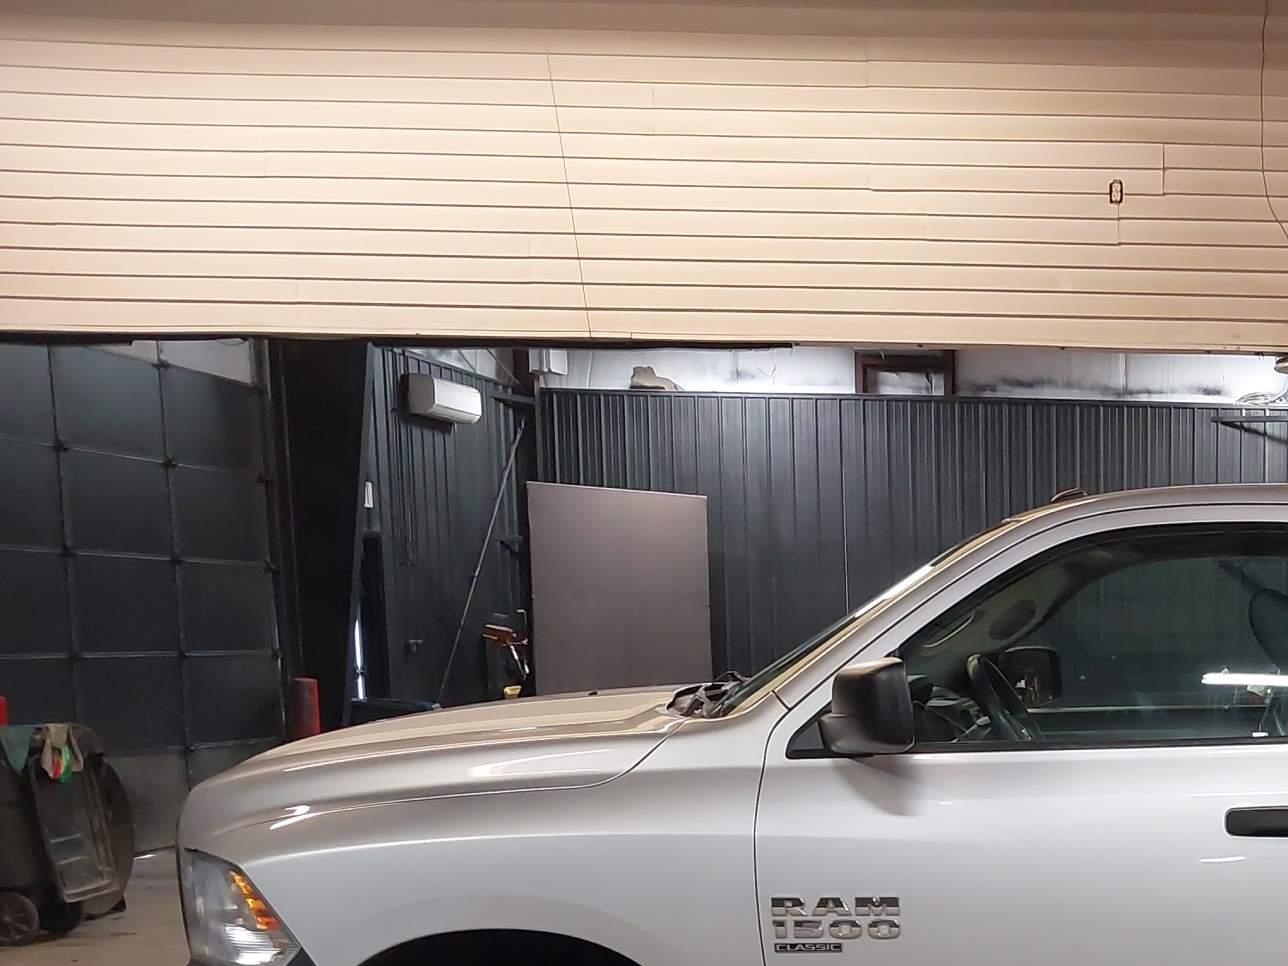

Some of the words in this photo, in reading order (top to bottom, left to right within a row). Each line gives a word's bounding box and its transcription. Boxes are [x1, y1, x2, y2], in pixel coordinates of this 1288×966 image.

[771, 897, 900, 916] RAM
[772, 919, 901, 939] 1500
[775, 943, 841, 951] CLASSIC
